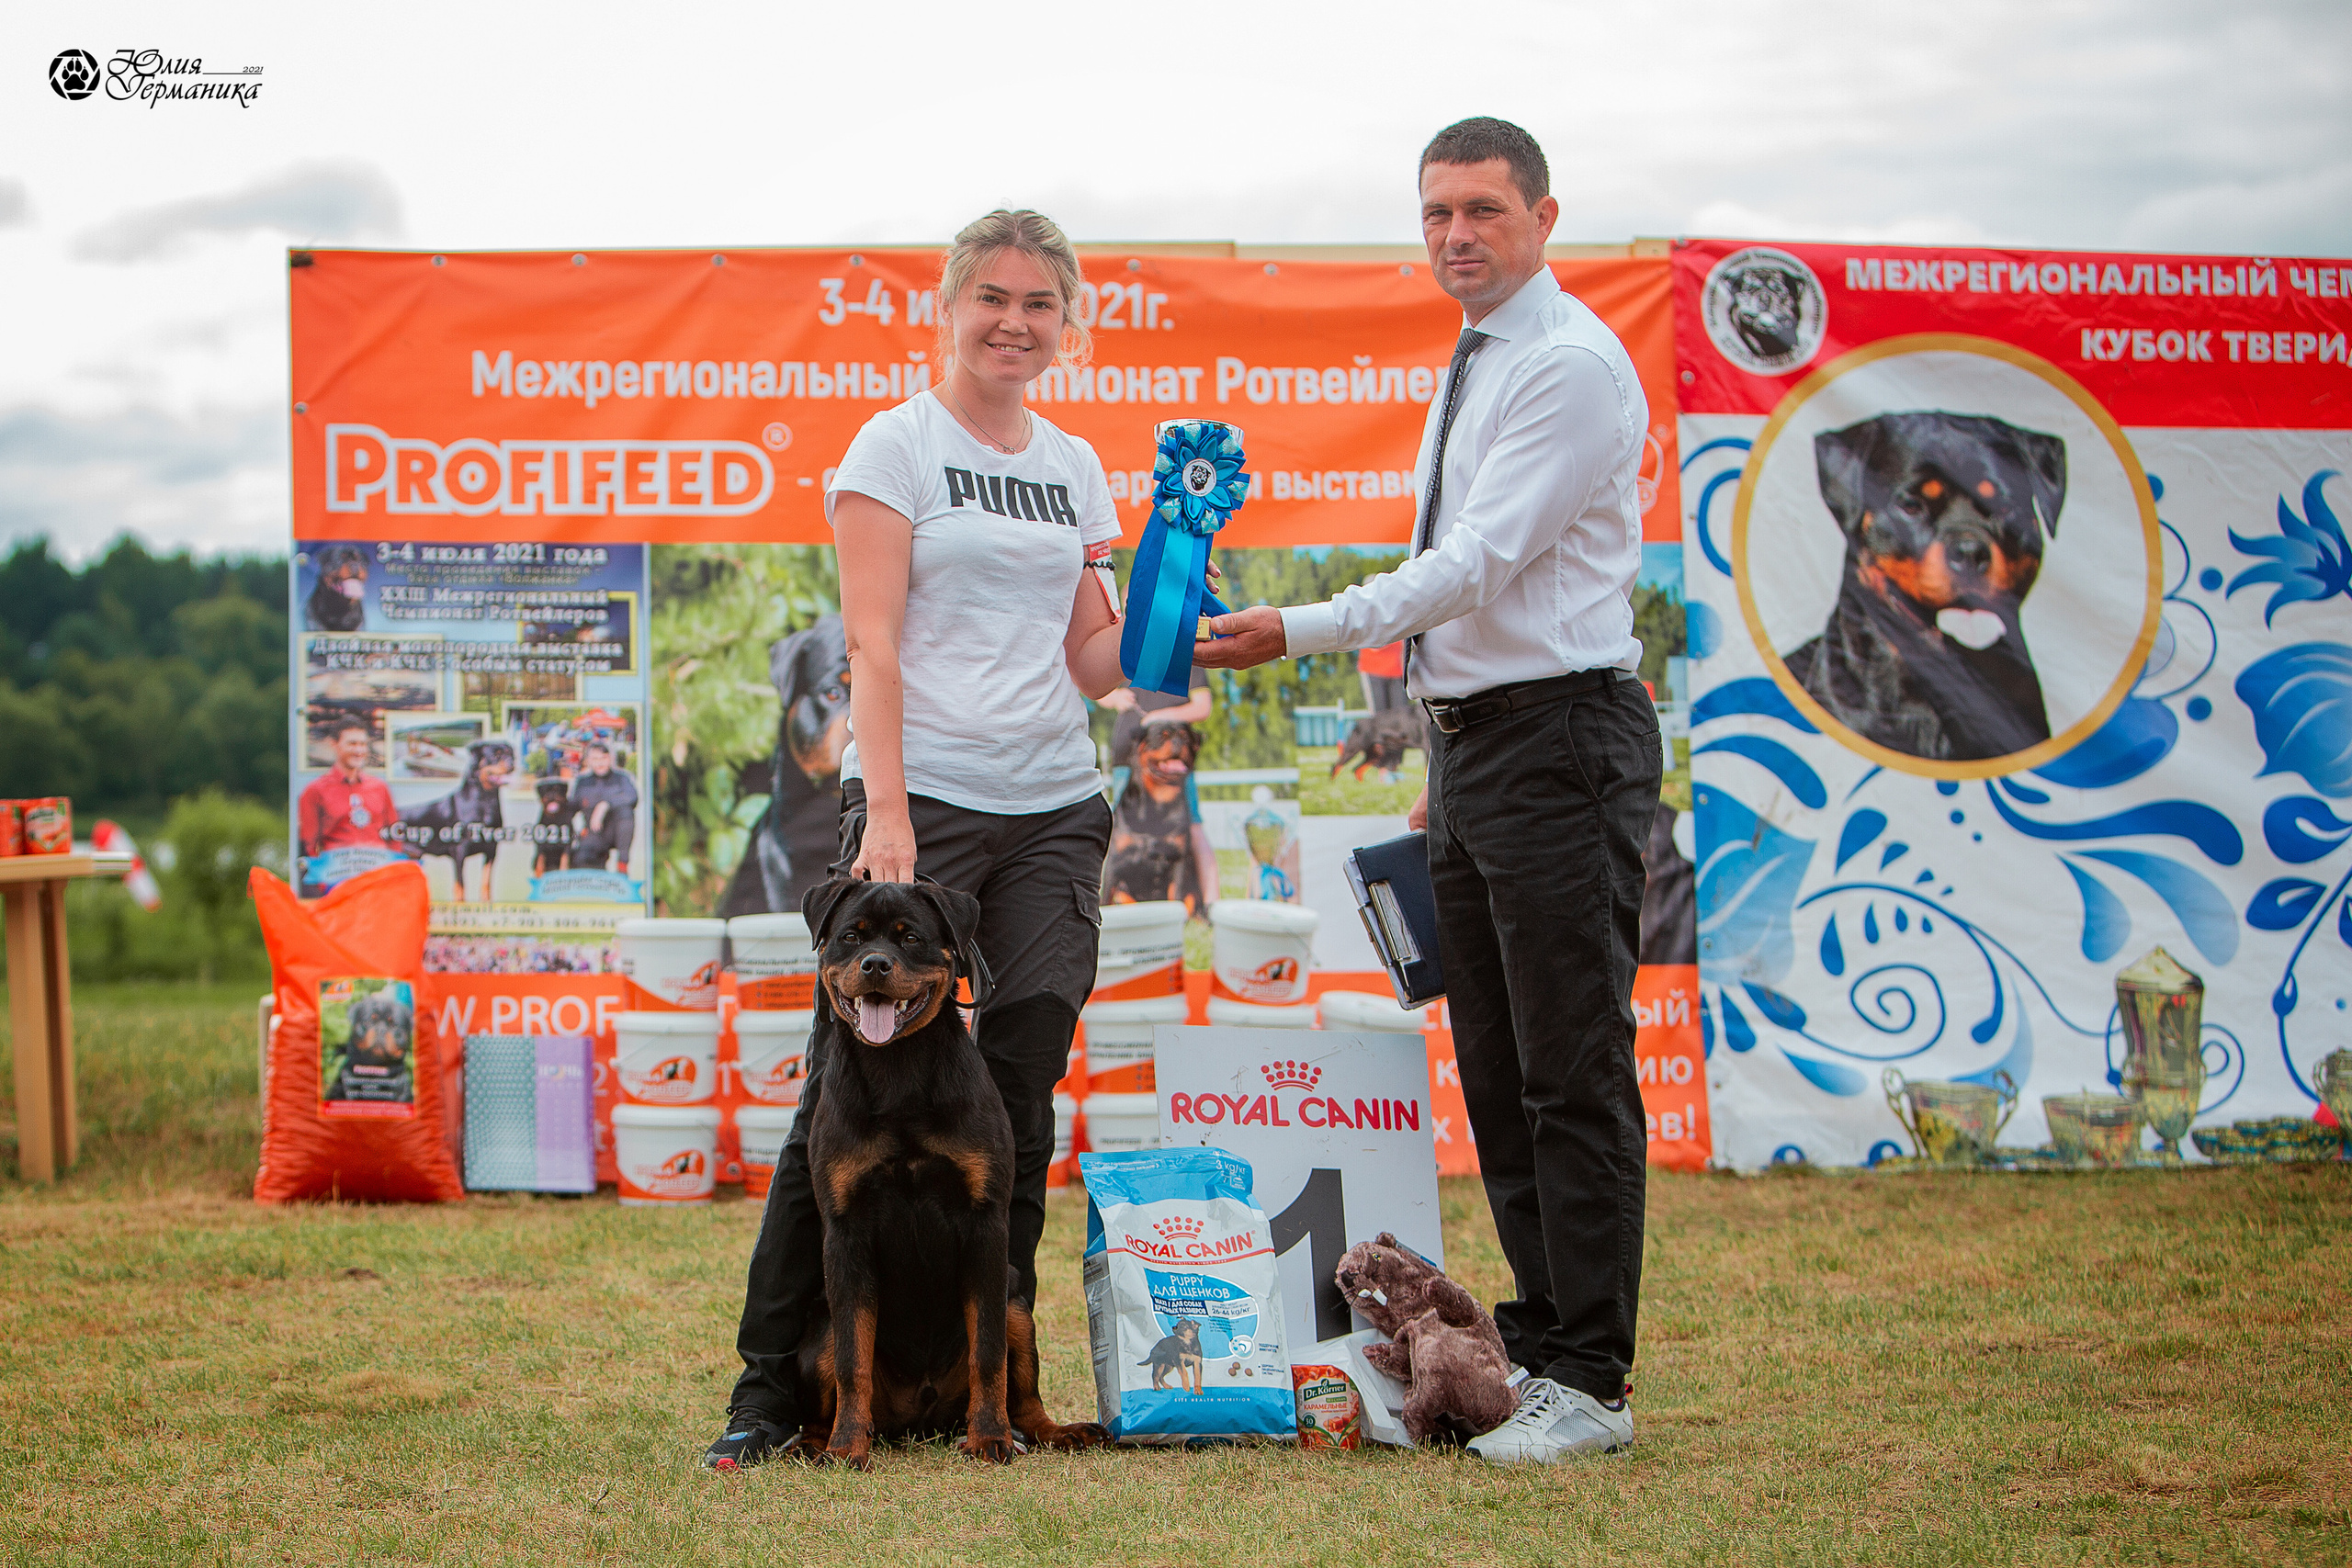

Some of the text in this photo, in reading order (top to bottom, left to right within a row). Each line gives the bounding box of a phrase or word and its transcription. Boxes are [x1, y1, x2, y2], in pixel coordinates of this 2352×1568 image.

[1845, 257, 2278, 297] МЕЖРЕГИОНАЛЬНЫЙ
[818, 278, 895, 326] 3-4
[1070, 281, 1175, 331] 021г.
[2080, 328, 2352, 367] КУБОК ТВЕРИ
[471, 350, 932, 407] Межрегиональный
[944, 466, 1078, 527] PUMA
[377, 542, 609, 566] 3-4 июля 2021 года
[433, 587, 609, 607] Межрегиональный
[381, 603, 609, 627] Чемпионат Ротвейлеров
[313, 637, 624, 660] Двойная монопородная выставка
[326, 654, 611, 677] КЧК и КЧК с особым статусом
[439, 822, 462, 842] of
[468, 822, 515, 842] Tver
[1170, 1091, 1291, 1126] ROYAL
[1298, 1097, 1420, 1132] CANIN
[1216, 1159, 1222, 1170] 3
[1125, 1232, 1253, 1258] ROYAL CANIN
[1270, 1168, 1352, 1343] 1
[1154, 1285, 1230, 1299] ДЛЯ ЩЕНКОВ
[1170, 1275, 1204, 1287] PUPPY
[1154, 1303, 1179, 1314] КРУПНЫХ
[1171, 1300, 1183, 1308] ДЛЯ
[1212, 1307, 1230, 1315] 26-44
